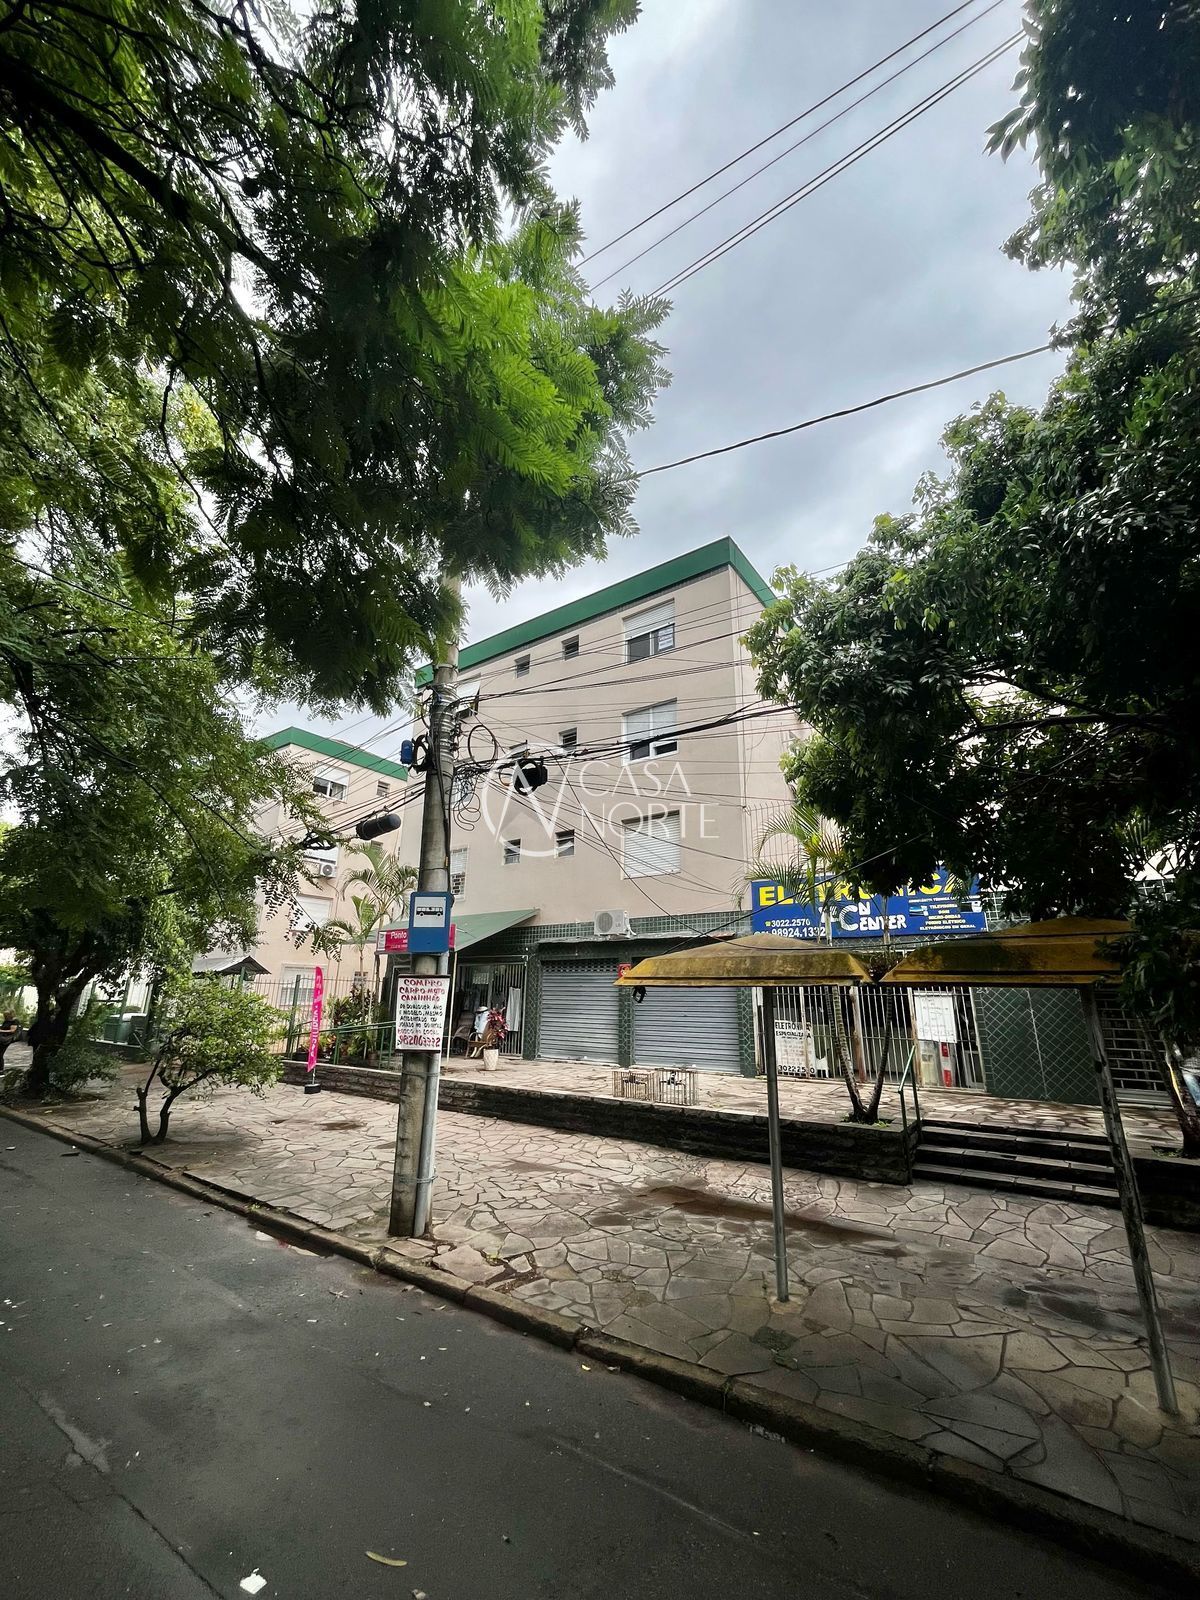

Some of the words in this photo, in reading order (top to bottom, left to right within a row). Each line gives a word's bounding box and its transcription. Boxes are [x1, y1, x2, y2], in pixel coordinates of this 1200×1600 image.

[771, 918, 811, 928] 3022.2570
[390, 931, 407, 940] Ponto
[403, 979, 443, 987] COMPRO
